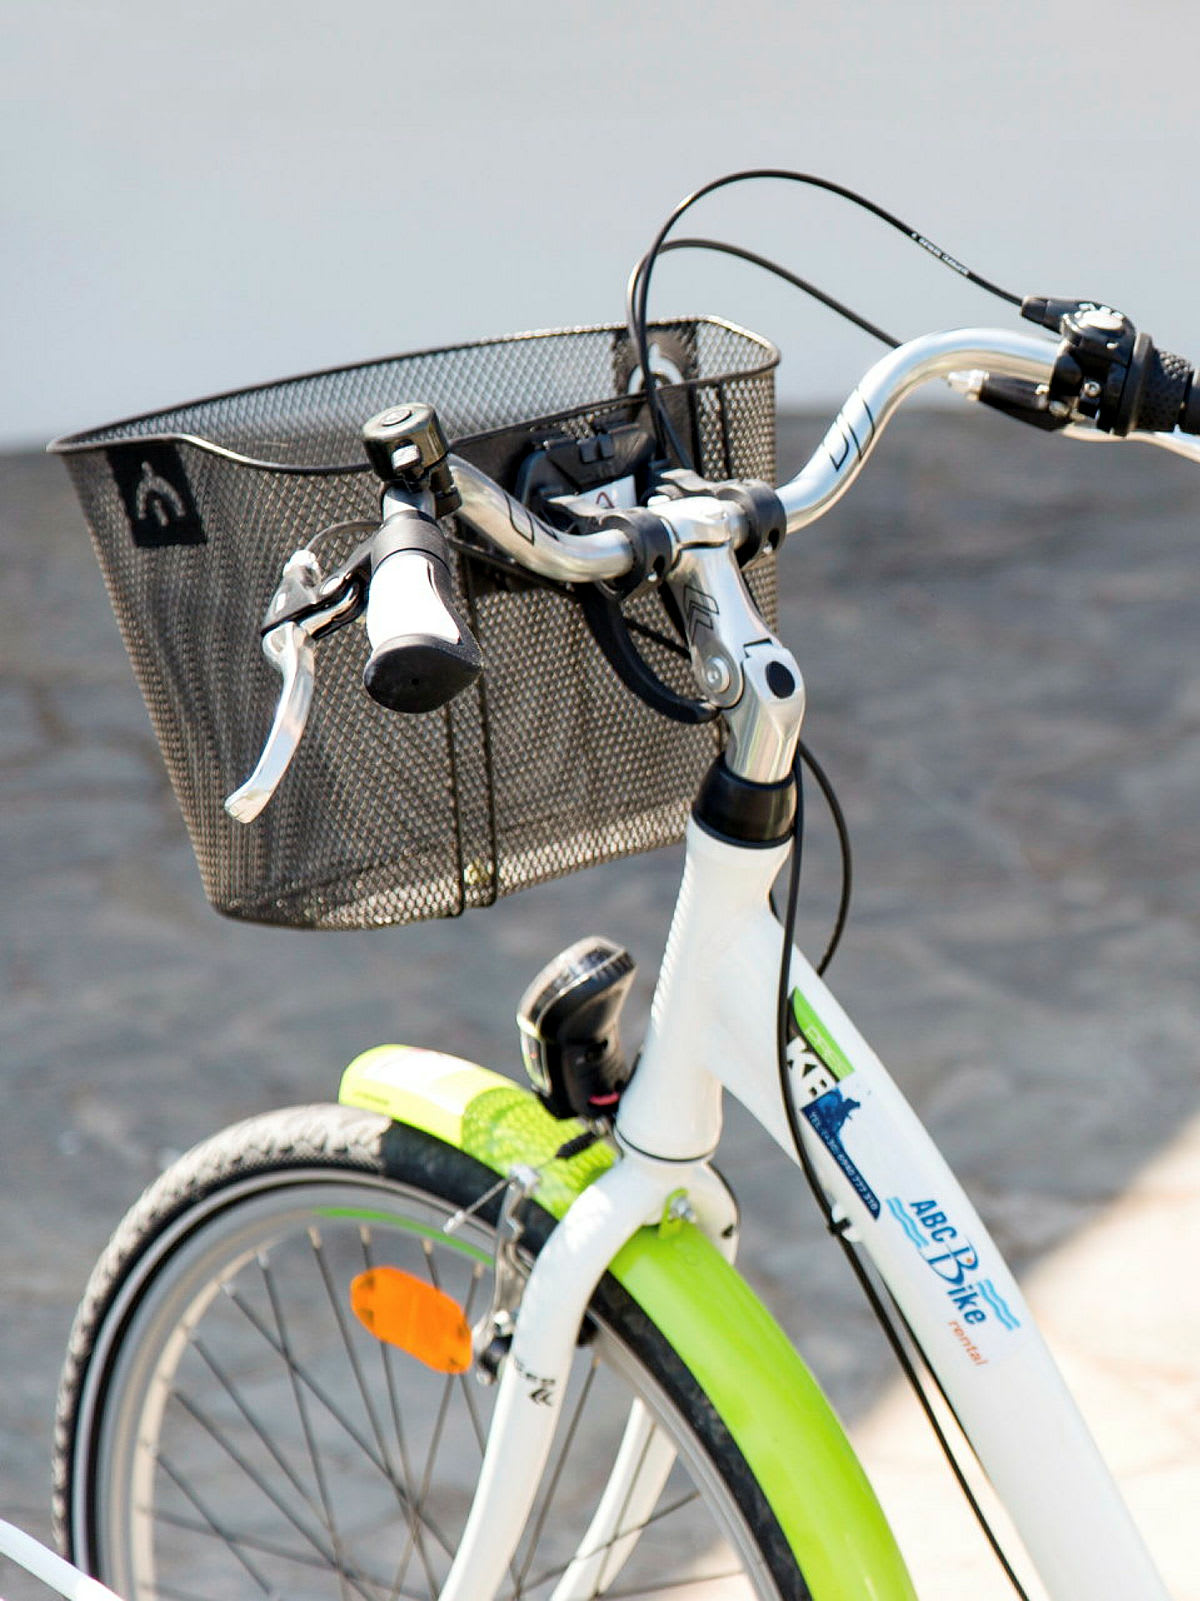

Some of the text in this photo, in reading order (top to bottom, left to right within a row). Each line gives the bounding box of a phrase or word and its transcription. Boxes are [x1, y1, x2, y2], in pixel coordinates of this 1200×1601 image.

[909, 1200, 986, 1324] ABC Bike
[948, 1319, 989, 1366] rental
